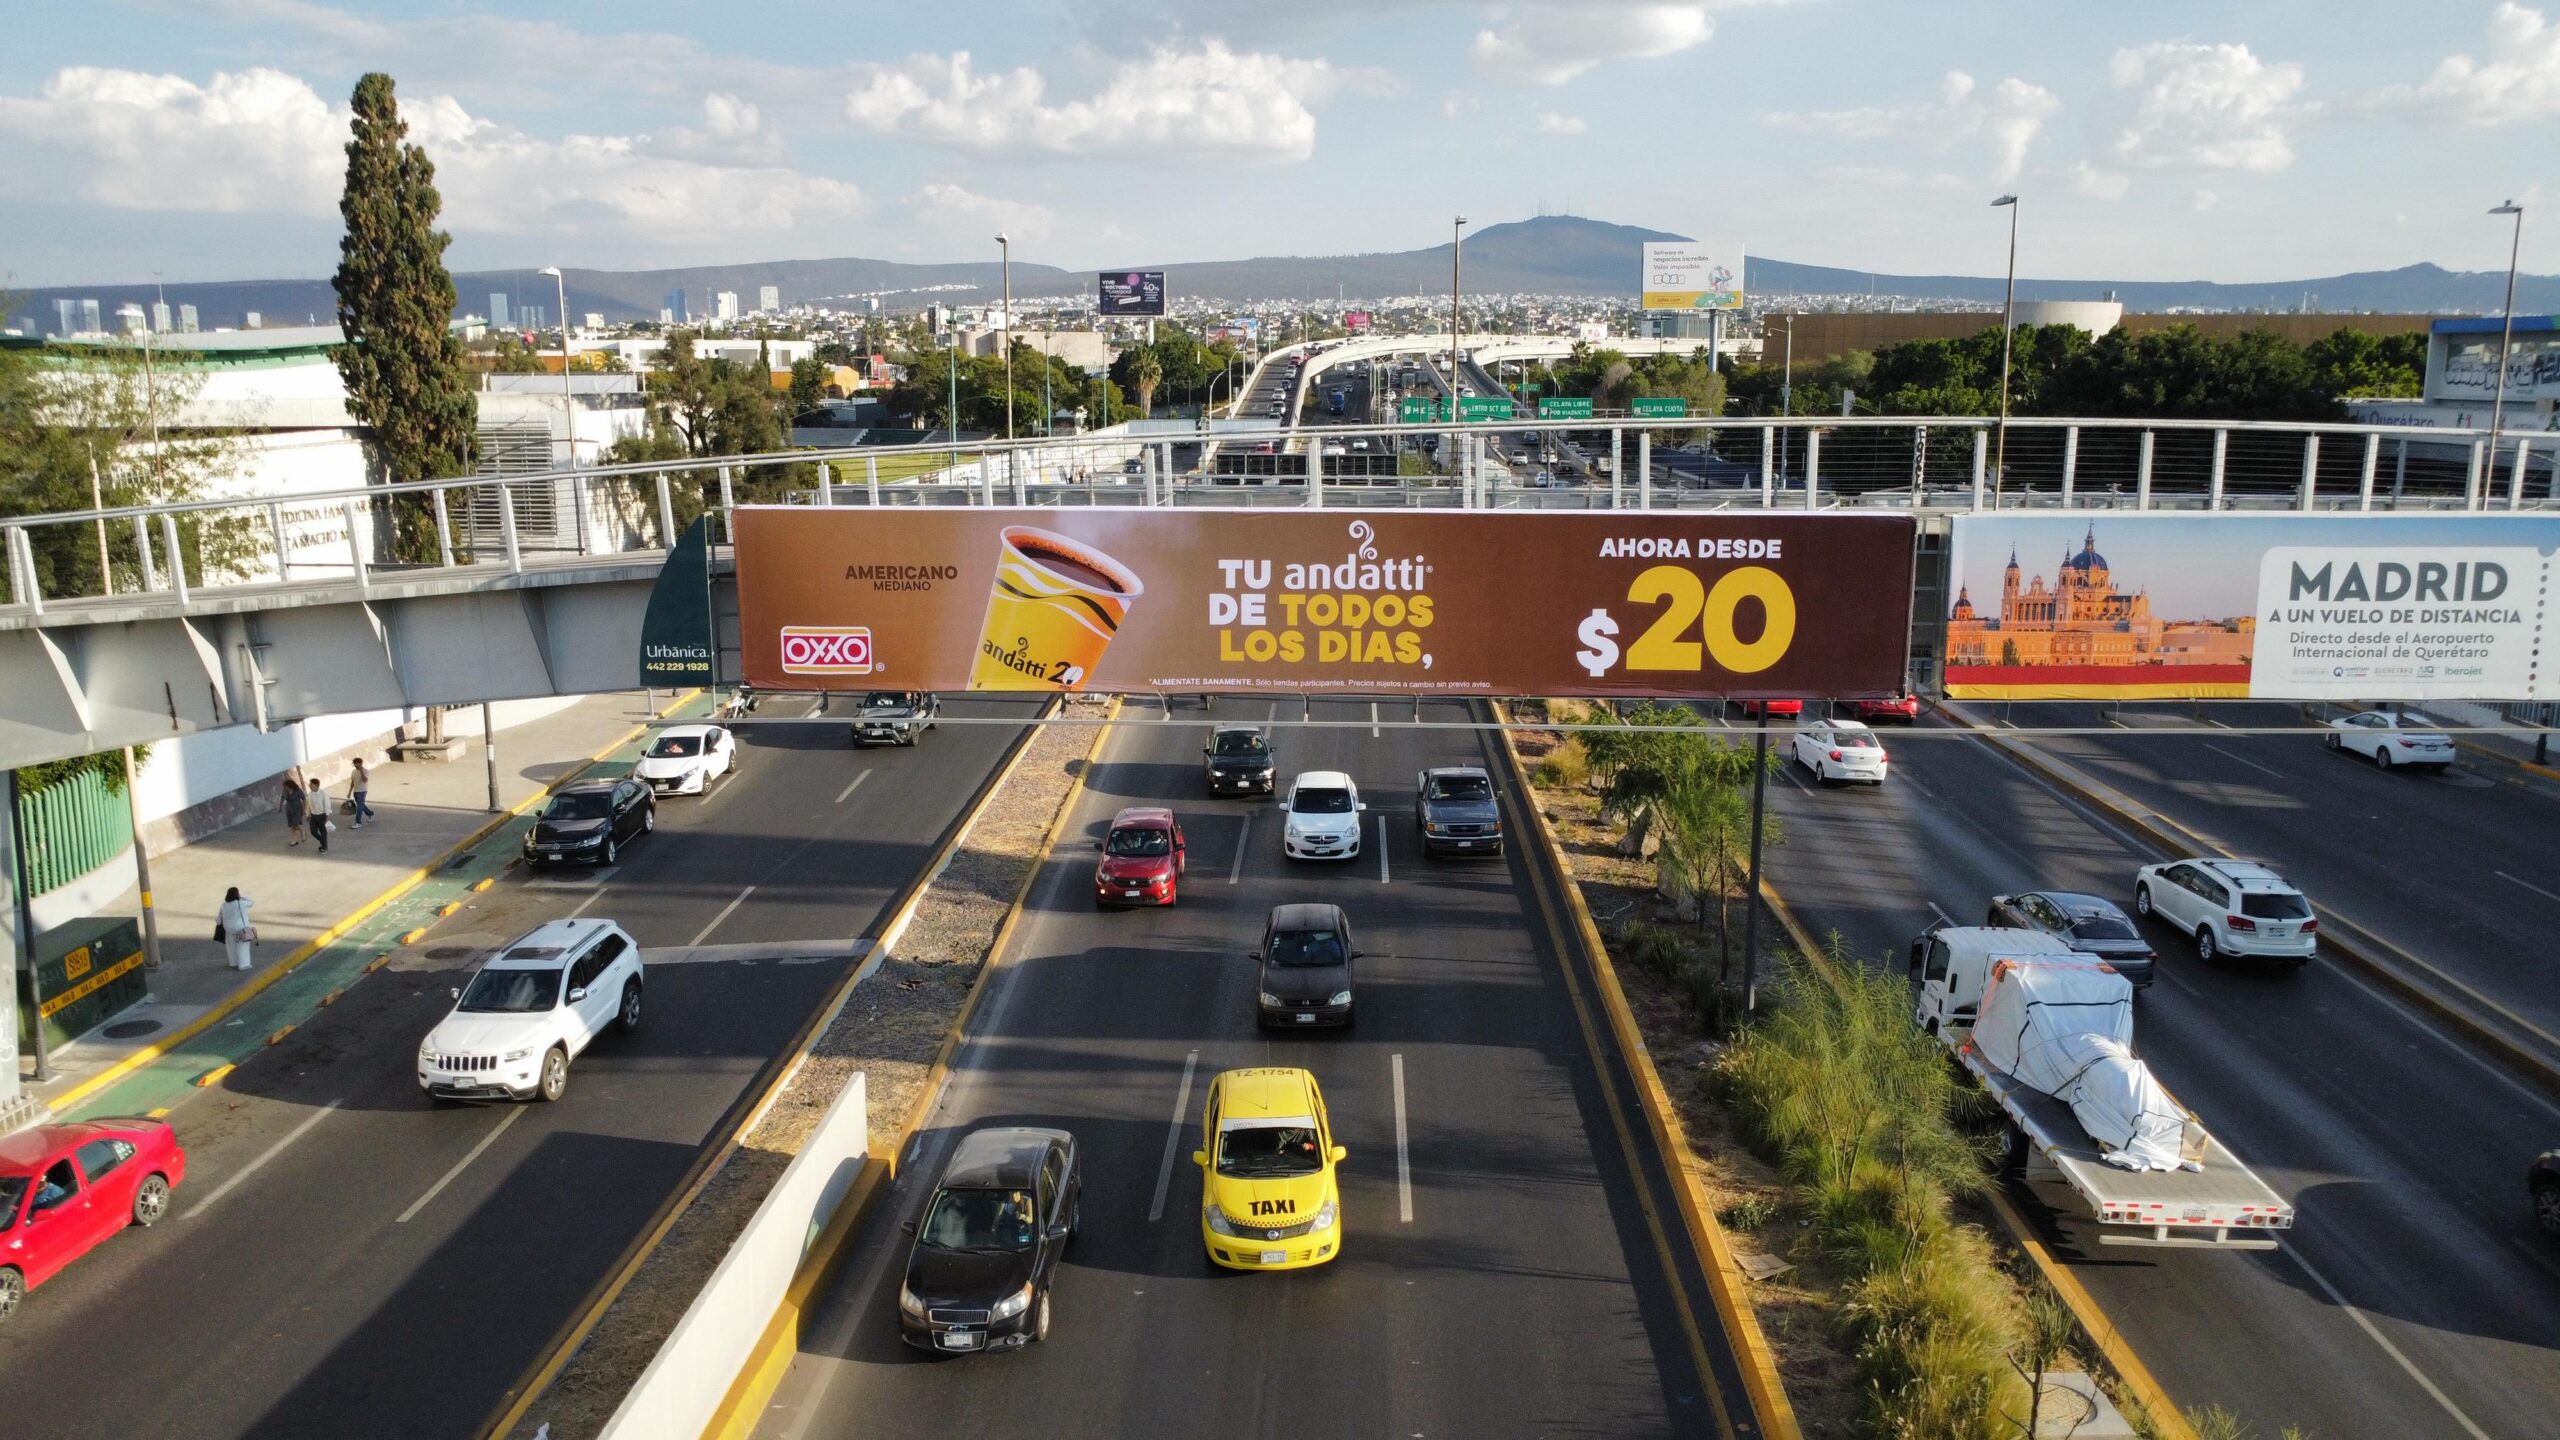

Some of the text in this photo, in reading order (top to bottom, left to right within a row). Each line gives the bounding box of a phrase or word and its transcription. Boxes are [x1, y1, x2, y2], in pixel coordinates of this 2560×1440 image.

[1599, 537, 1782, 559] AHORA DESDE
[845, 565, 958, 580] AMERICANO
[1218, 553, 1424, 591] TU andatti
[873, 581, 931, 591] MEDIANO
[2289, 561, 2508, 602] MADRID
[1209, 593, 1435, 627] DE TODOS
[2269, 608, 2522, 624] A UN VUELO DE DISTANCIA
[1576, 565, 1796, 677] $20
[1220, 629, 1305, 664] LOS
[2289, 632, 2495, 647] Directo desde el Aeropuerto
[786, 634, 868, 666] OXXO
[983, 638, 1047, 679] andatti
[2292, 646, 2489, 661] Internacional de Querétaro
[646, 662, 709, 671] 442 229 1928
[1255, 678, 1272, 686] Sólo
[1273, 679, 1299, 687] tiendas
[1300, 680, 1347, 688] participantes.
[1348, 679, 1375, 687] Precios
[1376, 680, 1401, 688] sujetos
[1448, 681, 1470, 689] previo
[1235, 1069, 1294, 1078] TZ-1754
[1248, 1199, 1296, 1217] TAXI
